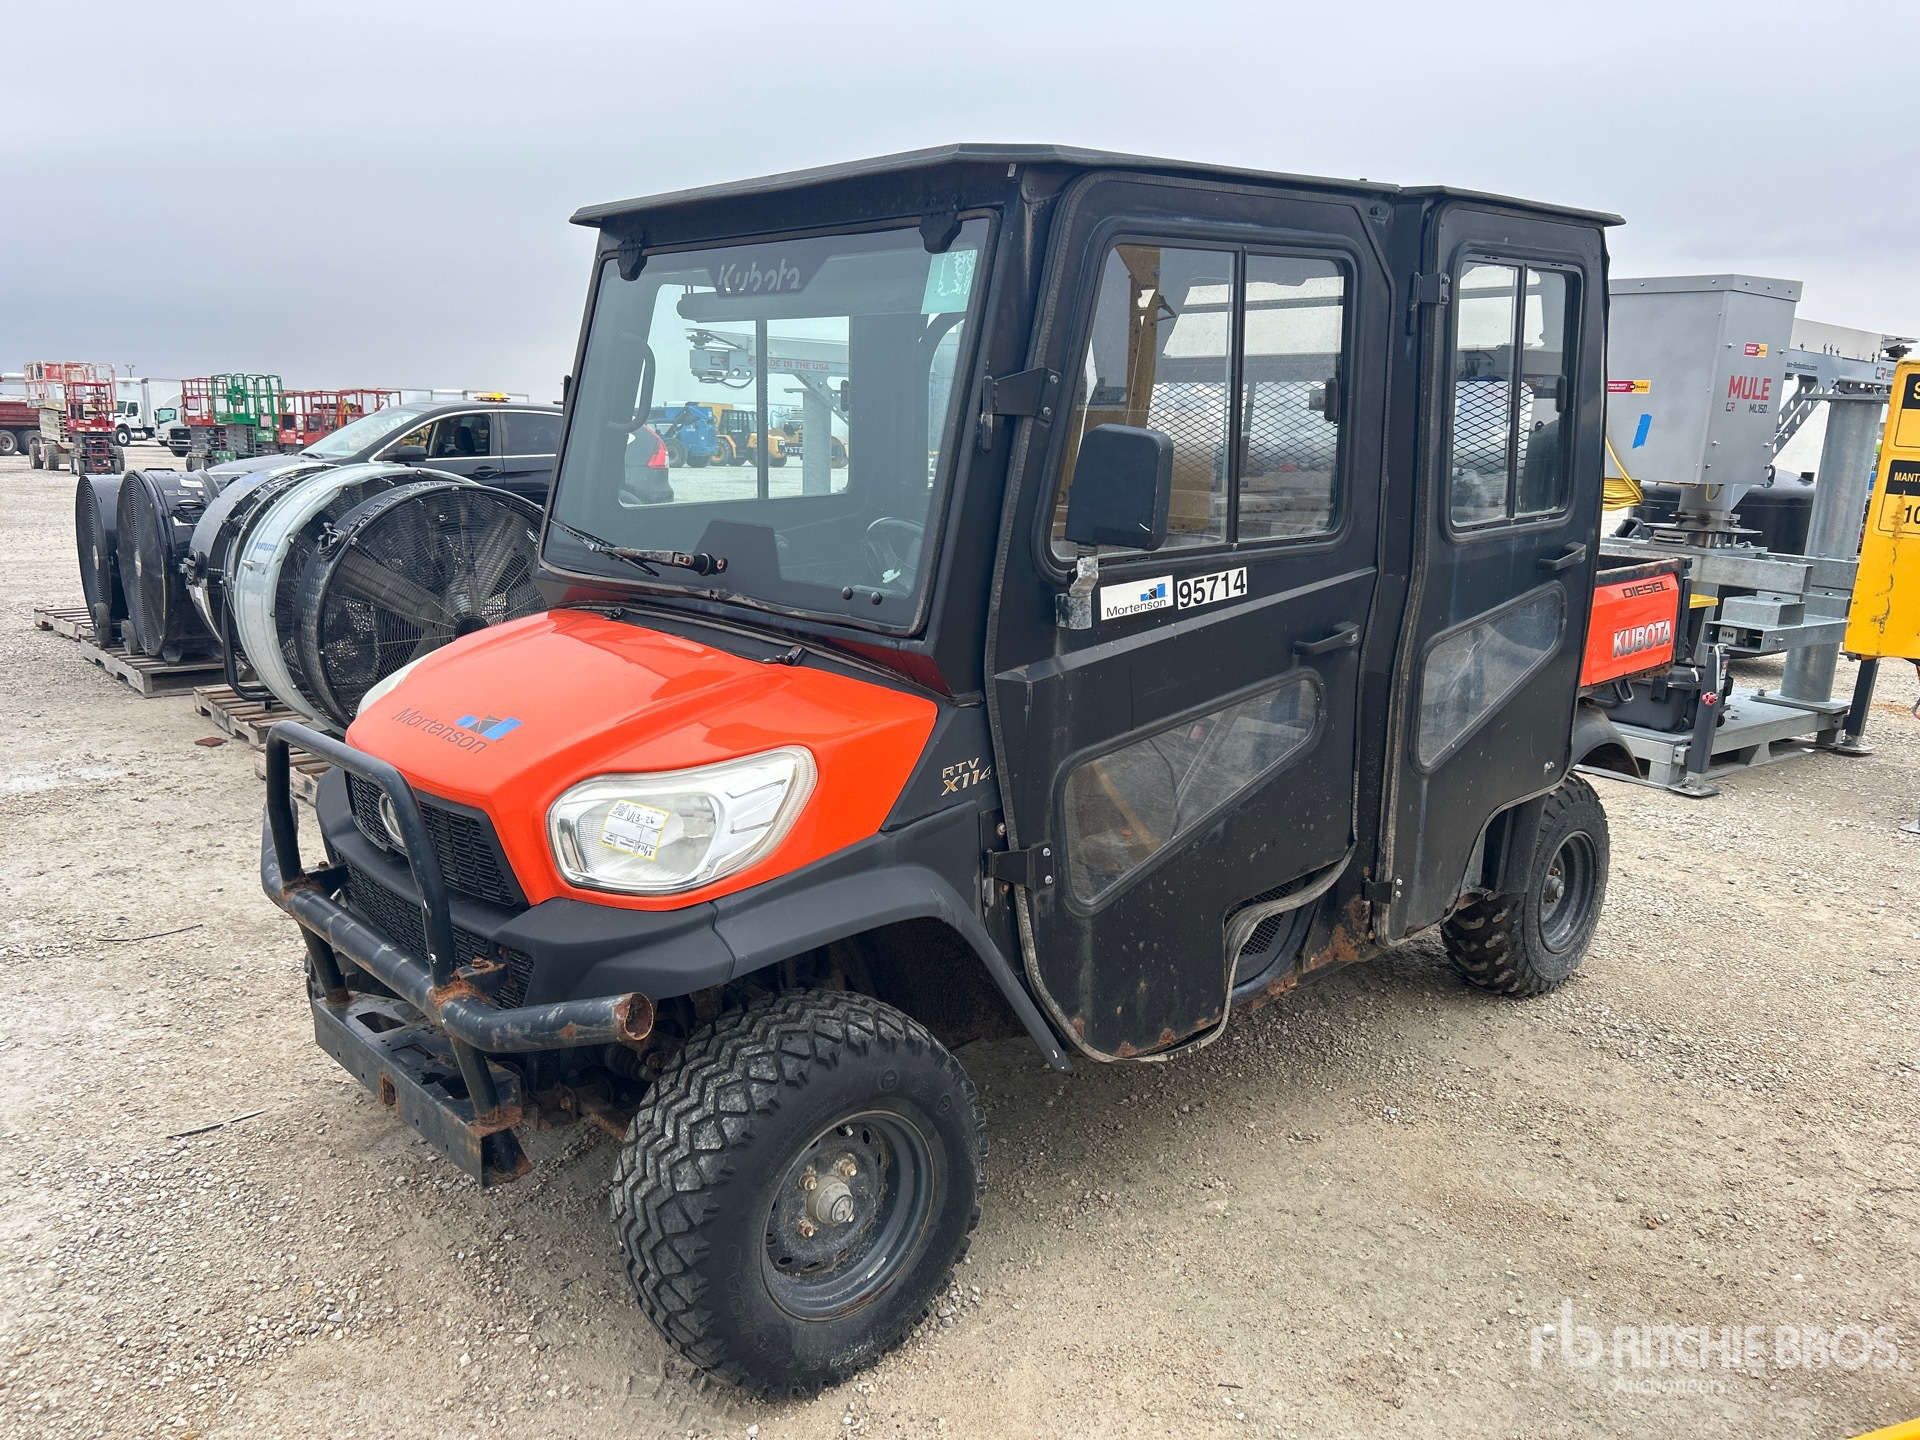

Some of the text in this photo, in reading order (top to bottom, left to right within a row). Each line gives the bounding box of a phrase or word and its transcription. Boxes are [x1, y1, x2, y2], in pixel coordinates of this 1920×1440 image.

[718, 259, 800, 293] Kubota
[783, 360, 792, 368] IN
[795, 361, 811, 369] THE
[812, 362, 830, 371] USA
[1728, 375, 1772, 401] MULE
[1893, 471, 1920, 483] MANT
[1178, 569, 1246, 608] 95714
[1622, 581, 1670, 599] DIESEL
[1106, 599, 1166, 618] Mortenson
[1612, 619, 1672, 659] KUBOTA
[392, 707, 488, 754] Mortenson
[942, 757, 980, 779] RTV
